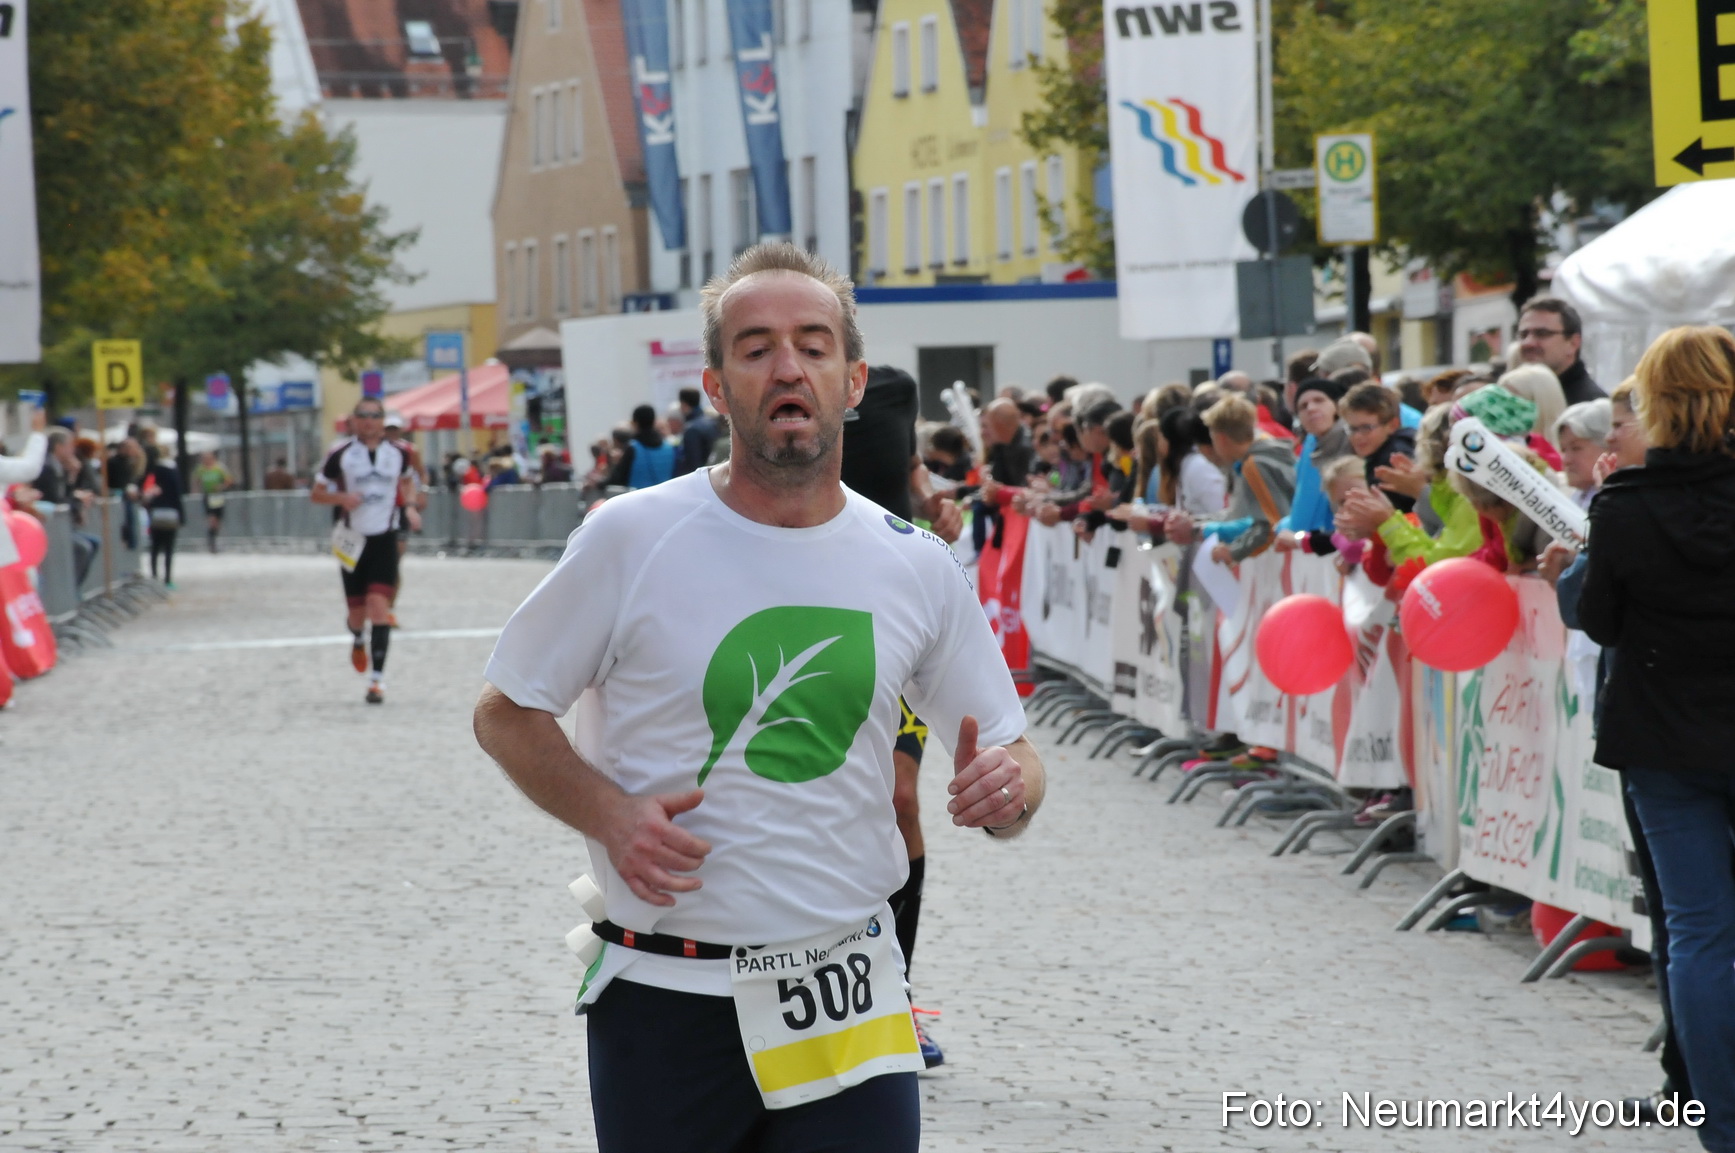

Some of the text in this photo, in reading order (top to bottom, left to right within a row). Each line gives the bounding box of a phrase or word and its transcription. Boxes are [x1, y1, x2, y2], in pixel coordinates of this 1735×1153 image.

[107, 362, 130, 393] D
[736, 952, 802, 974] PARTL
[777, 953, 873, 1030] 508
